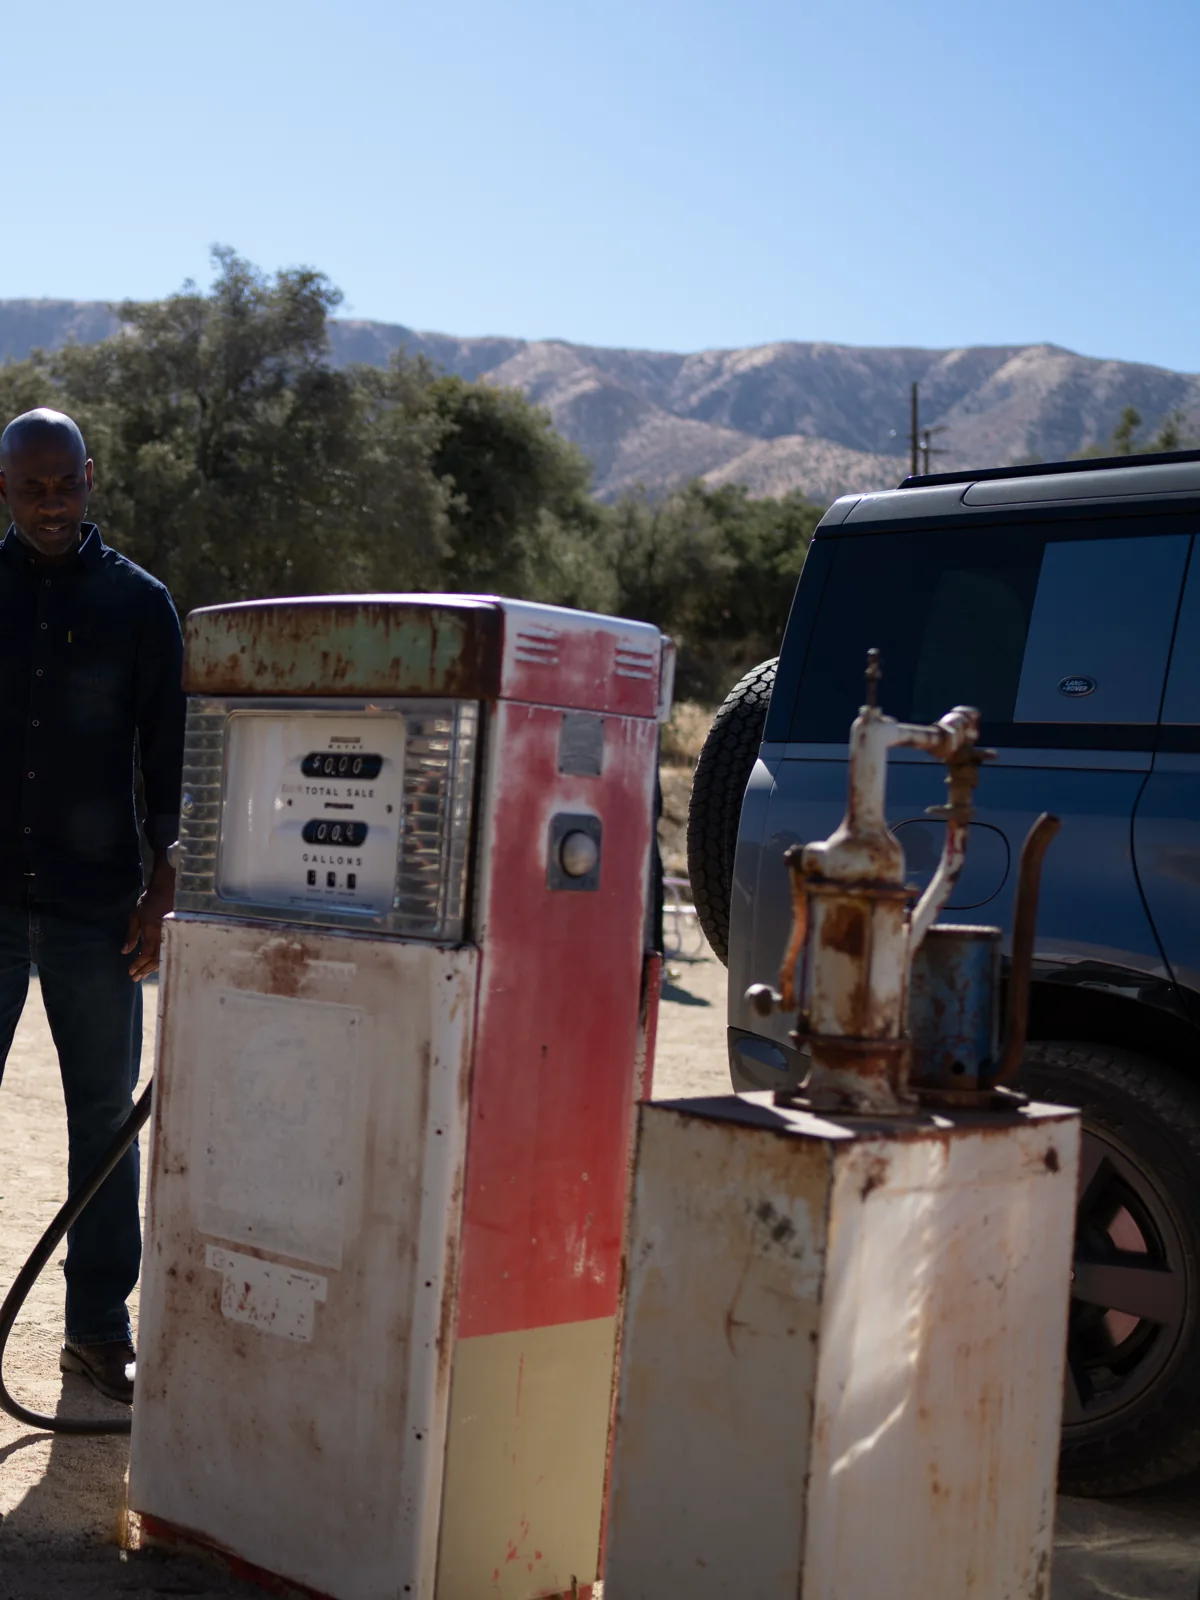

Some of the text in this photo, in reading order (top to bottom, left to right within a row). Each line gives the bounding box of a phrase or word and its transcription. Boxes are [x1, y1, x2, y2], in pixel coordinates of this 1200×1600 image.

[305, 786, 339, 796] TOTAL
[346, 788, 375, 799] SALE
[303, 853, 362, 866] GALLONS
